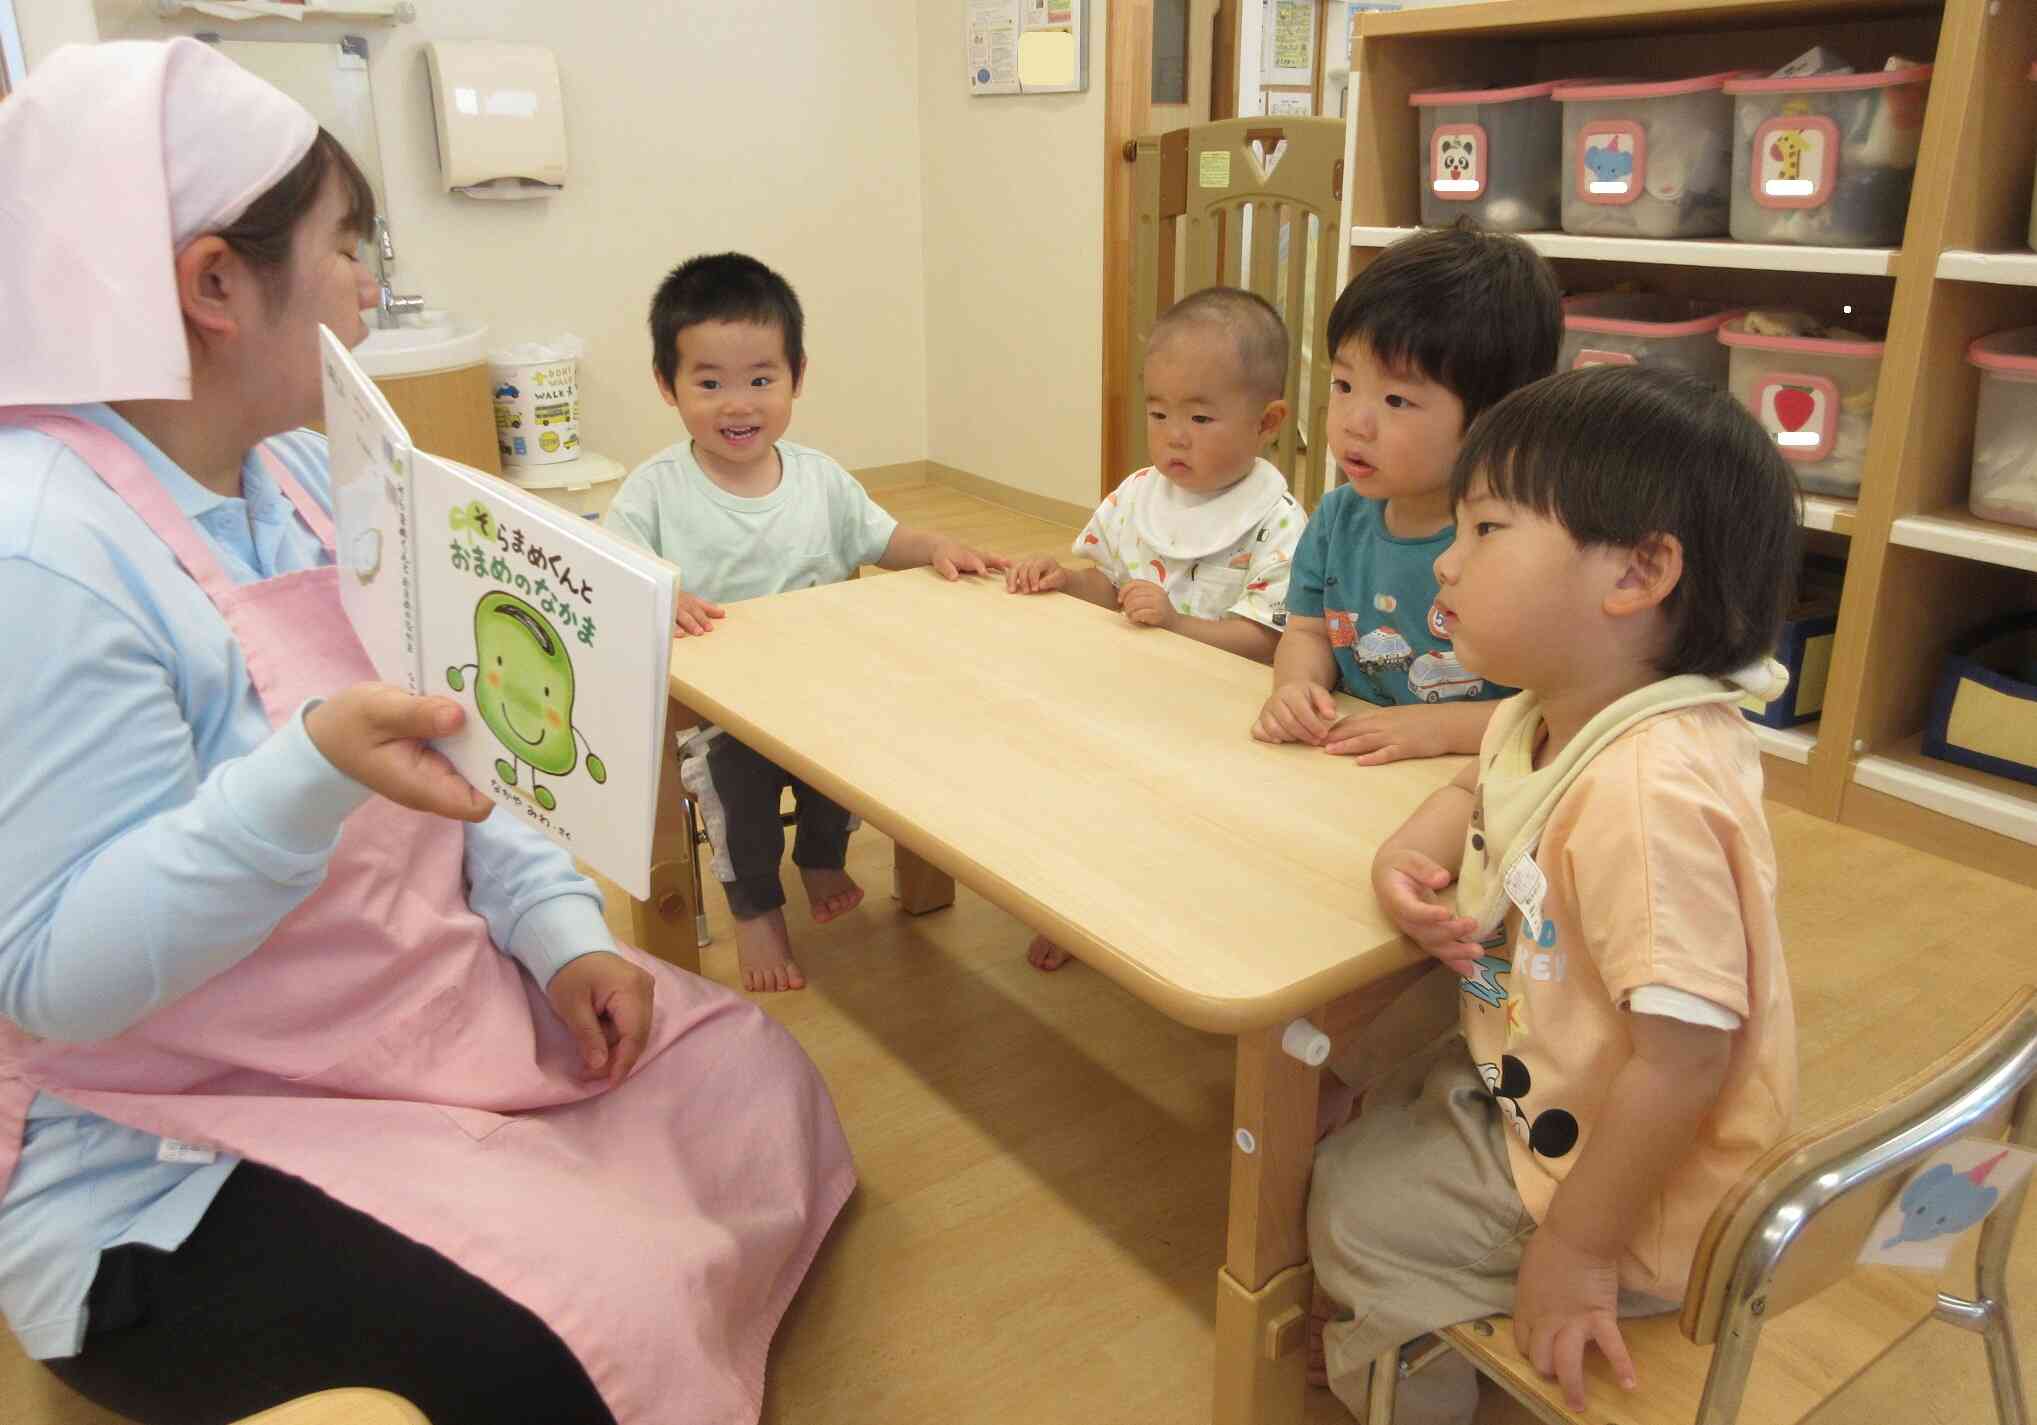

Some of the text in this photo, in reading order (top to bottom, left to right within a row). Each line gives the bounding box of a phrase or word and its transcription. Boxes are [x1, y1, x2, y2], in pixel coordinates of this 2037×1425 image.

[534, 389, 564, 401] WALK
[450, 538, 597, 649] おまめのなかま
[474, 504, 593, 605] そらまめくんと
